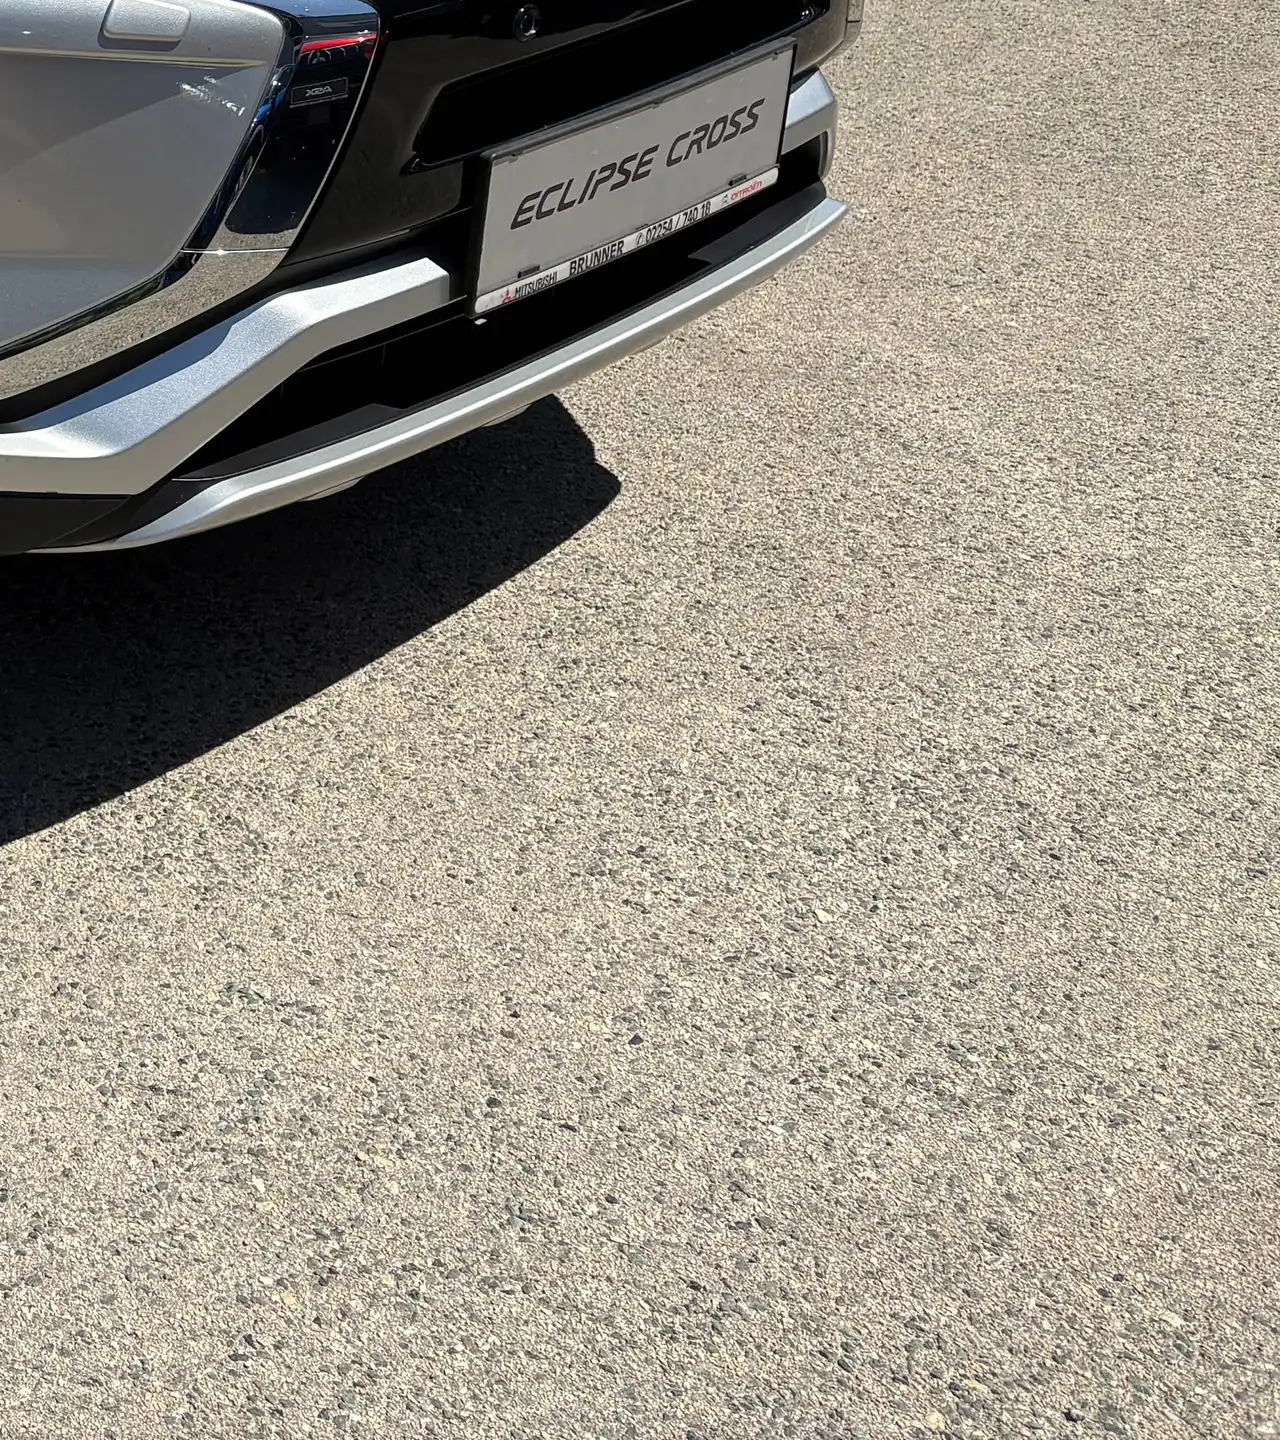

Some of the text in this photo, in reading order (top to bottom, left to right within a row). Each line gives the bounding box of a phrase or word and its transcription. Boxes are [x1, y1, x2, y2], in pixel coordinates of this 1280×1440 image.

[510, 97, 766, 231] ECLIPSE CROSS
[514, 271, 558, 298] MITSUBISHI
[569, 240, 624, 276] BRUNNER
[645, 217, 673, 243] 02254
[683, 206, 699, 226] 740
[701, 200, 712, 218] 18
